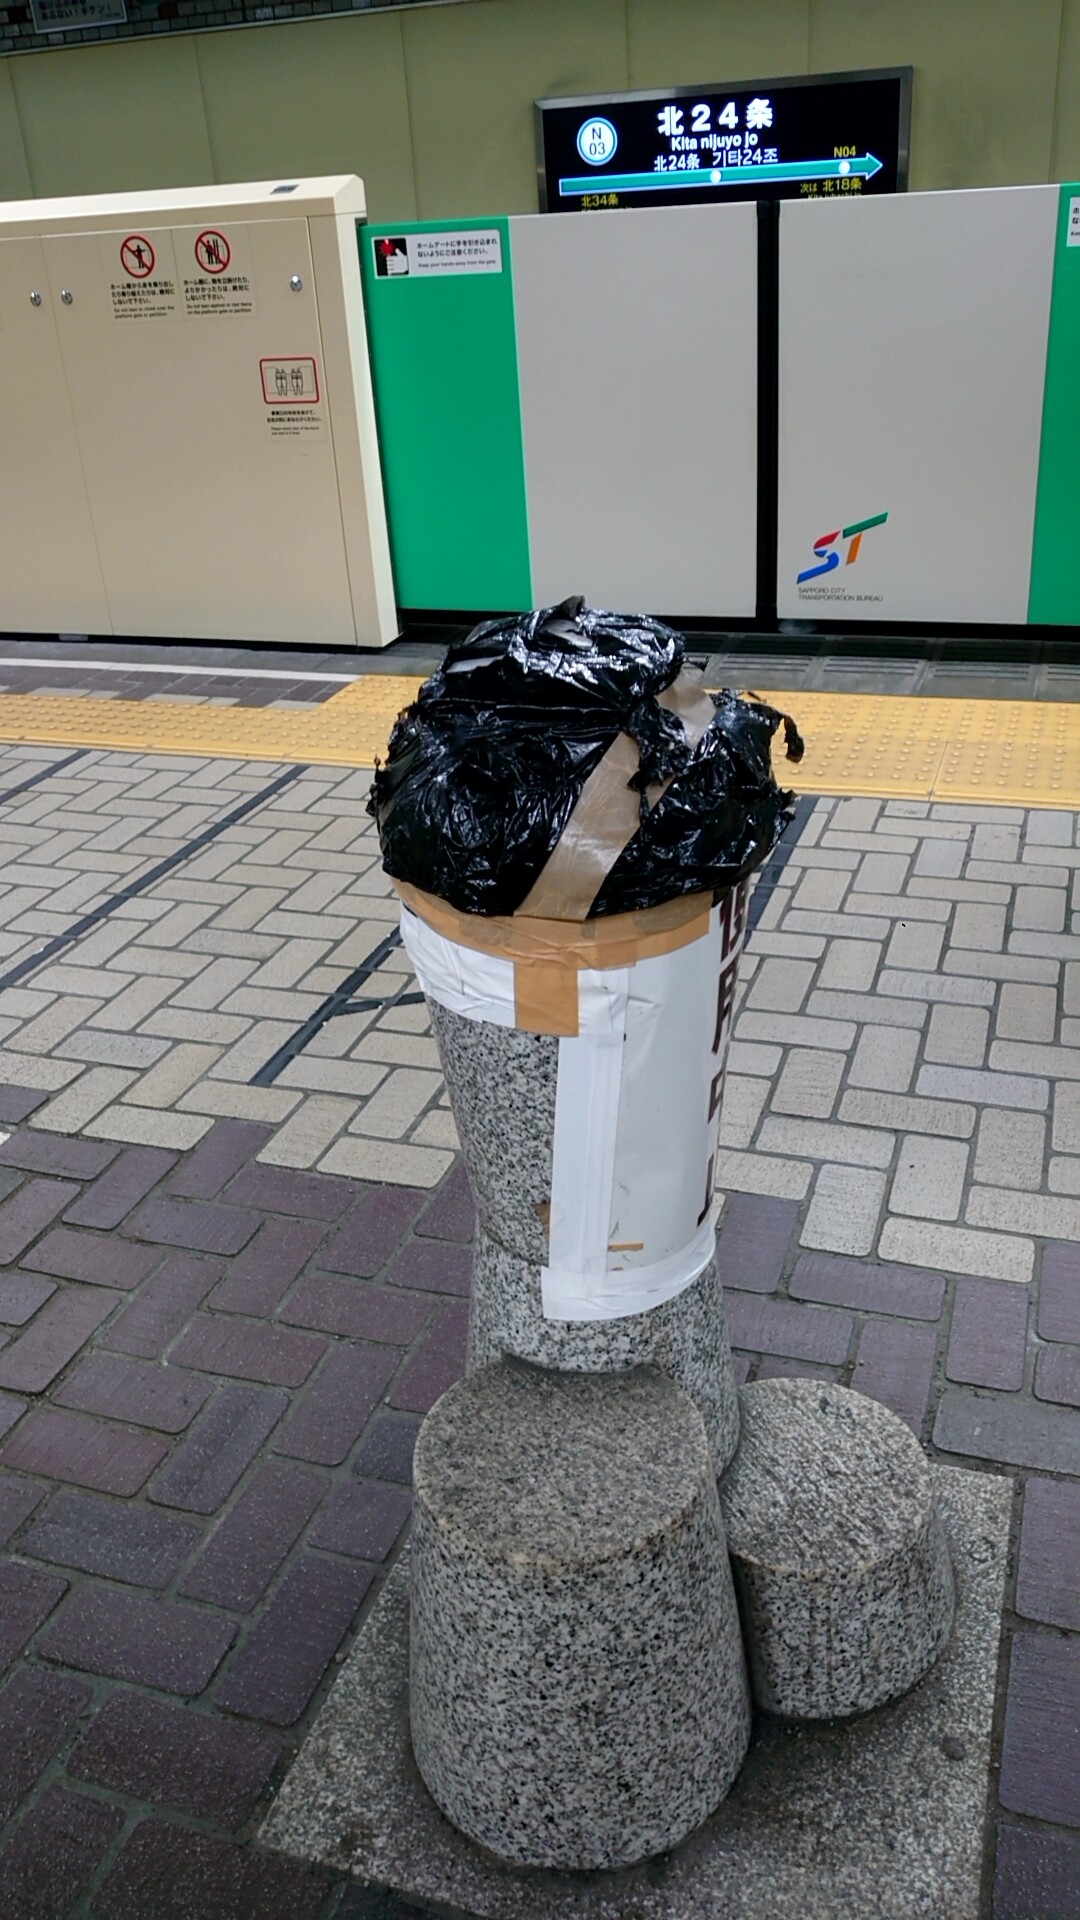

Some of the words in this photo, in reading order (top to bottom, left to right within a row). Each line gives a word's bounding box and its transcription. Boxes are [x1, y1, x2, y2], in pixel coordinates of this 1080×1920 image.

[657, 98, 773, 136] 北24条
[592, 127, 602, 140] N
[671, 136, 698, 151] Kita
[700, 133, 742, 151] nijuyo
[744, 131, 758, 149] jo
[589, 142, 606, 156] 03
[711, 147, 779, 167] 기타24조
[833, 145, 857, 158] N04
[653, 153, 700, 172] 北24条
[822, 176, 862, 193] 北18条
[581, 192, 619, 208] 北34条
